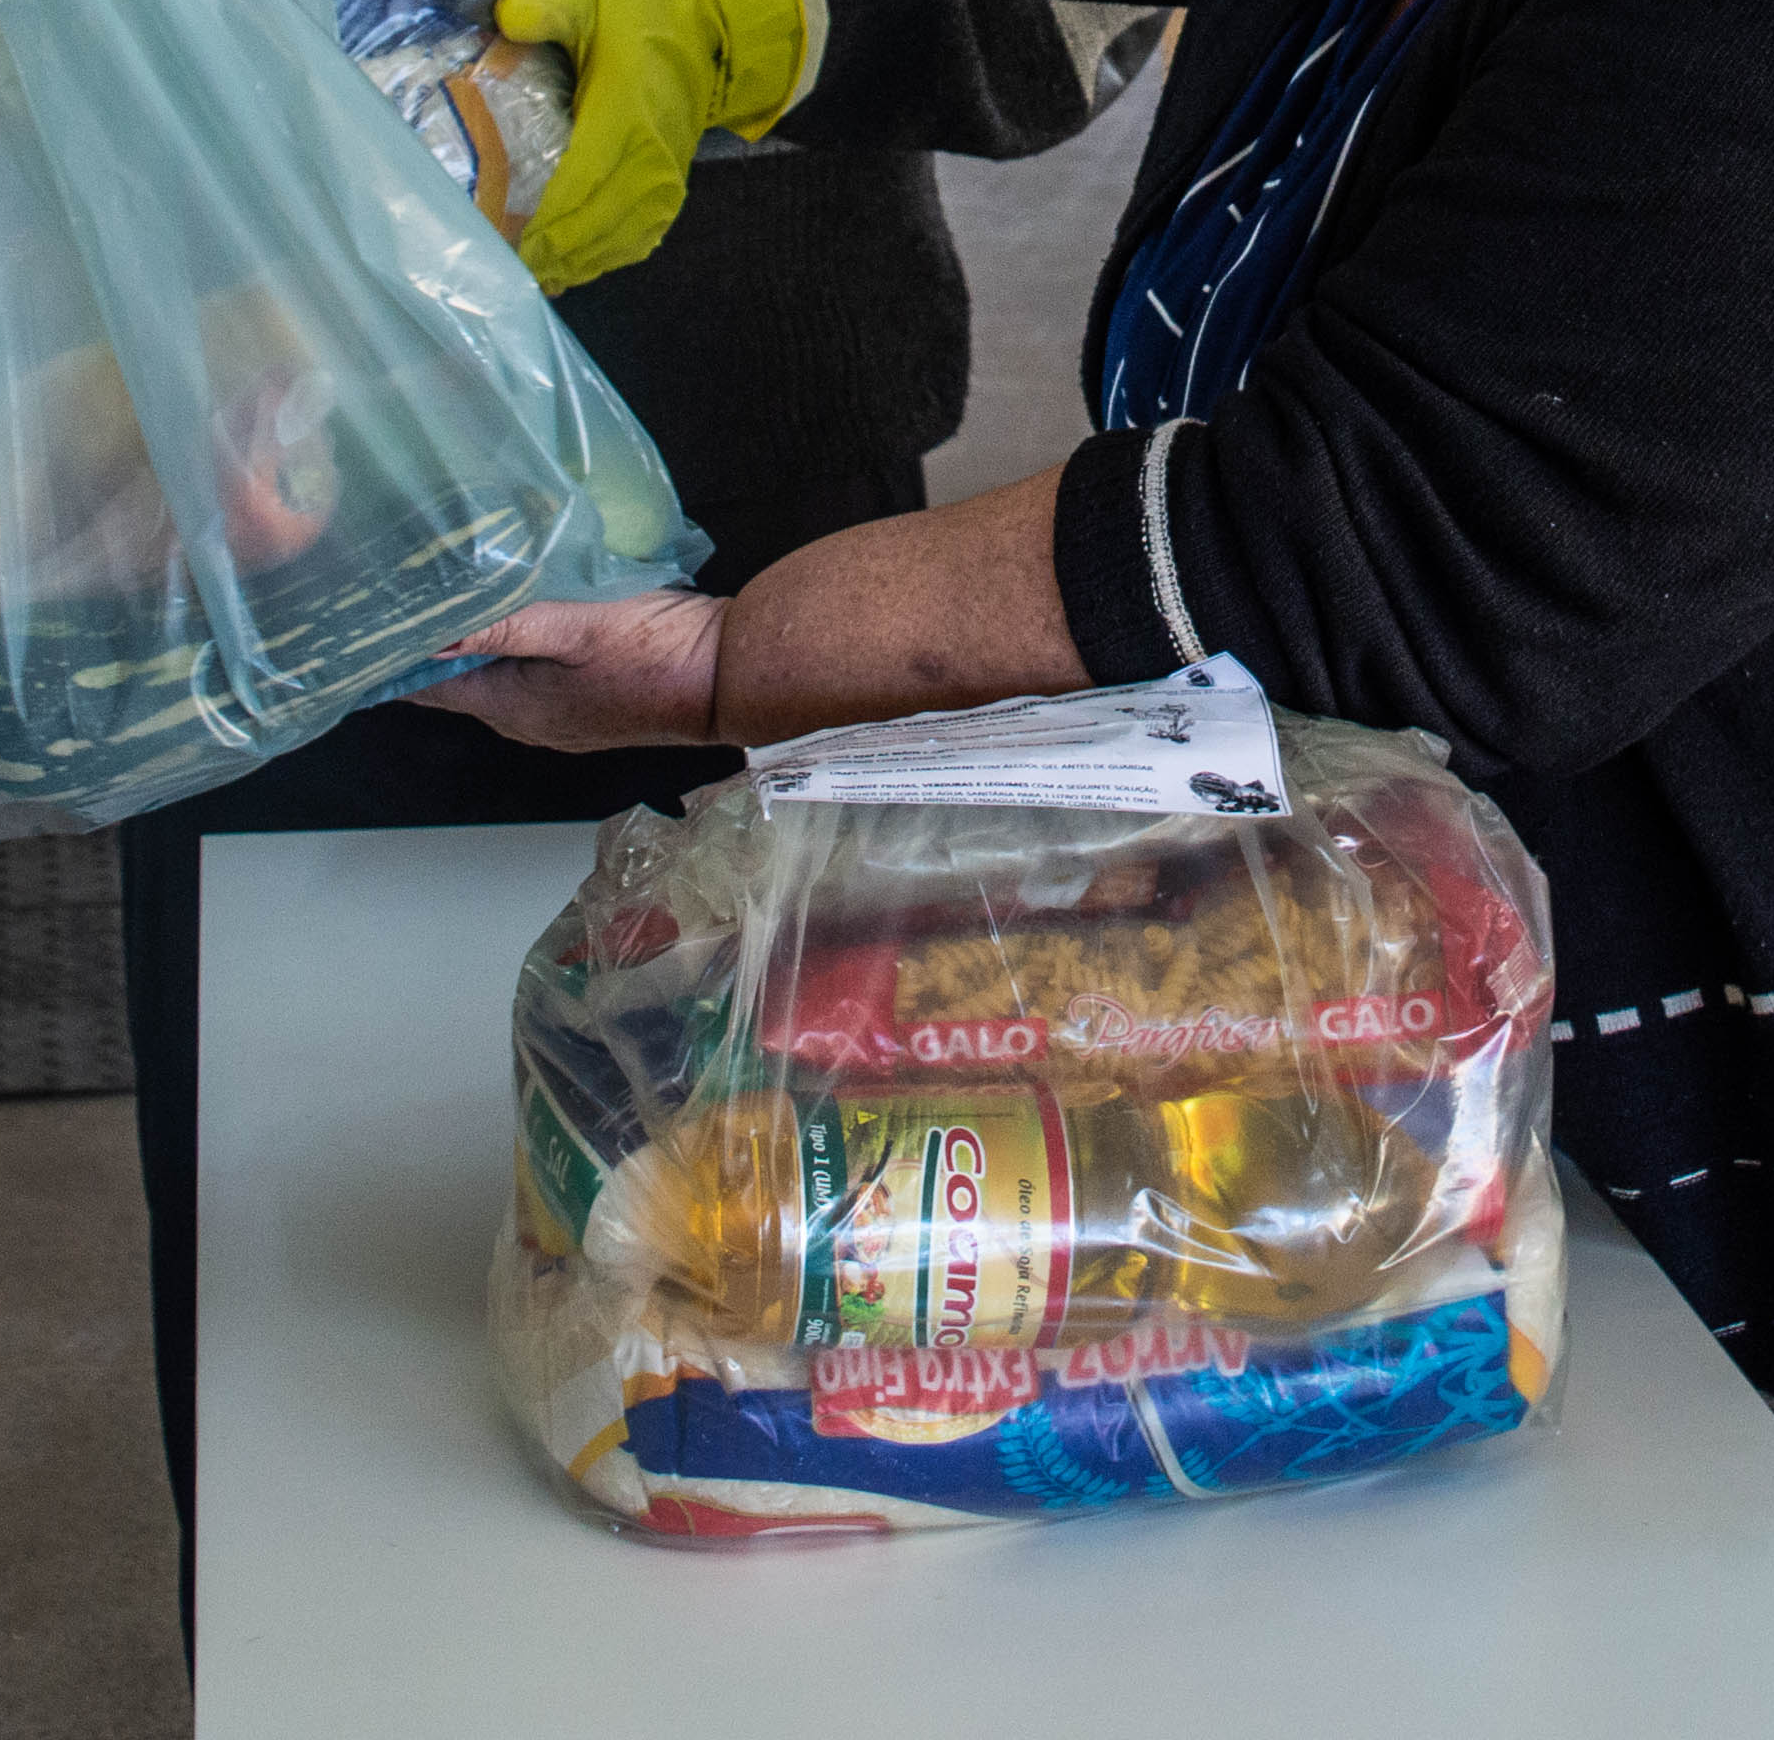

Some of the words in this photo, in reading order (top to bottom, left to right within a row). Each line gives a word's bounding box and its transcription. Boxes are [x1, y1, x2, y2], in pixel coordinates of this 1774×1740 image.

[1318, 997, 1437, 1045] GALO
[909, 1023, 1039, 1064] GALO
[809, 1123, 828, 1153] Tipo
[1018, 1178, 1037, 1215] Óleo
[931, 1125, 987, 1350] Coamo
[1017, 1246, 1034, 1281] Soja
[818, 1348, 906, 1403] Fino
[916, 1348, 1031, 1403] Extra
